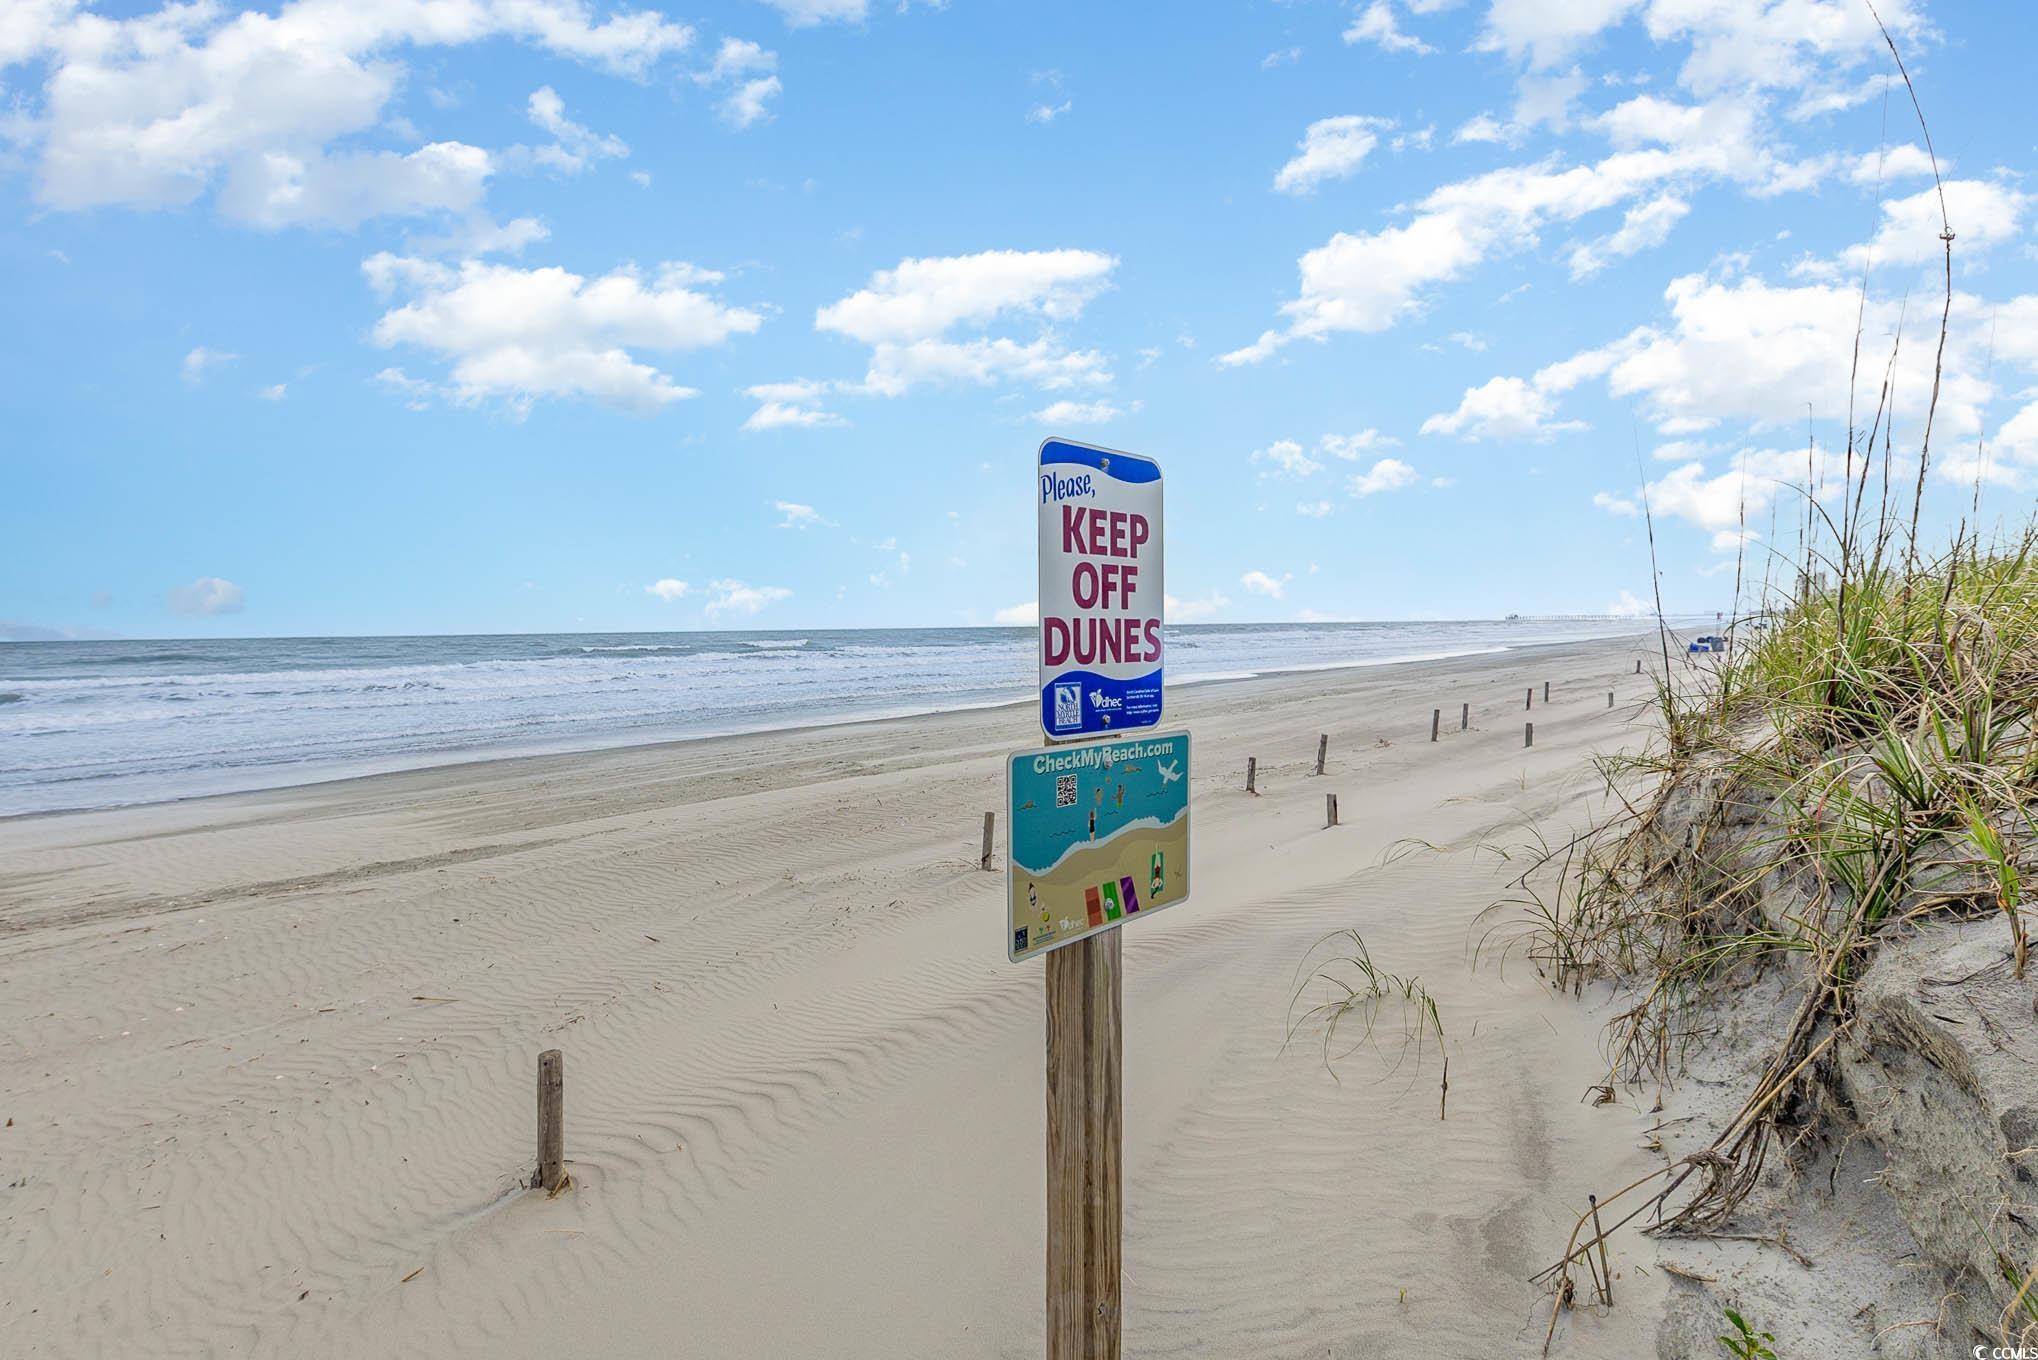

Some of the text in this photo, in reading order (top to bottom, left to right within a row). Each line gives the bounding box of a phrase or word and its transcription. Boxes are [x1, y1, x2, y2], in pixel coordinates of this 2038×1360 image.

[1041, 471, 1096, 504] Please,
[1062, 504, 1149, 558] KEEP
[1072, 562, 1138, 610] OFF
[1044, 617, 1161, 666] DUNES
[1033, 740, 1173, 774] CheckMyBeach.com
